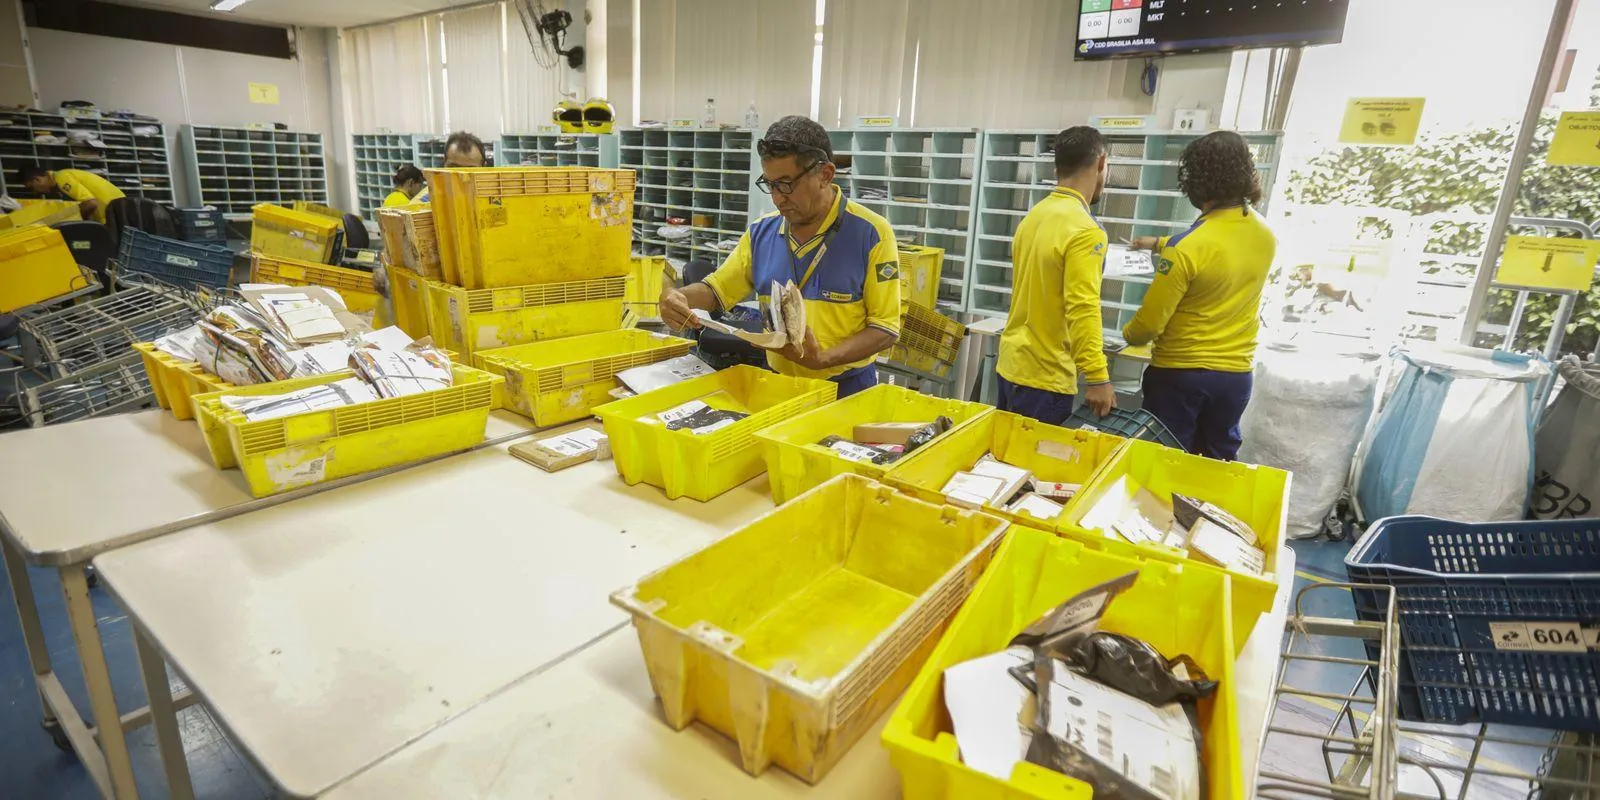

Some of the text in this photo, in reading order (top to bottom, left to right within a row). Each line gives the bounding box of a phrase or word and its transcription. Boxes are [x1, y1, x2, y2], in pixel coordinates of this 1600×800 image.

[1149, 0, 1165, 9] MLT
[1147, 13, 1164, 21] MKT
[1533, 628, 1579, 645] 604
